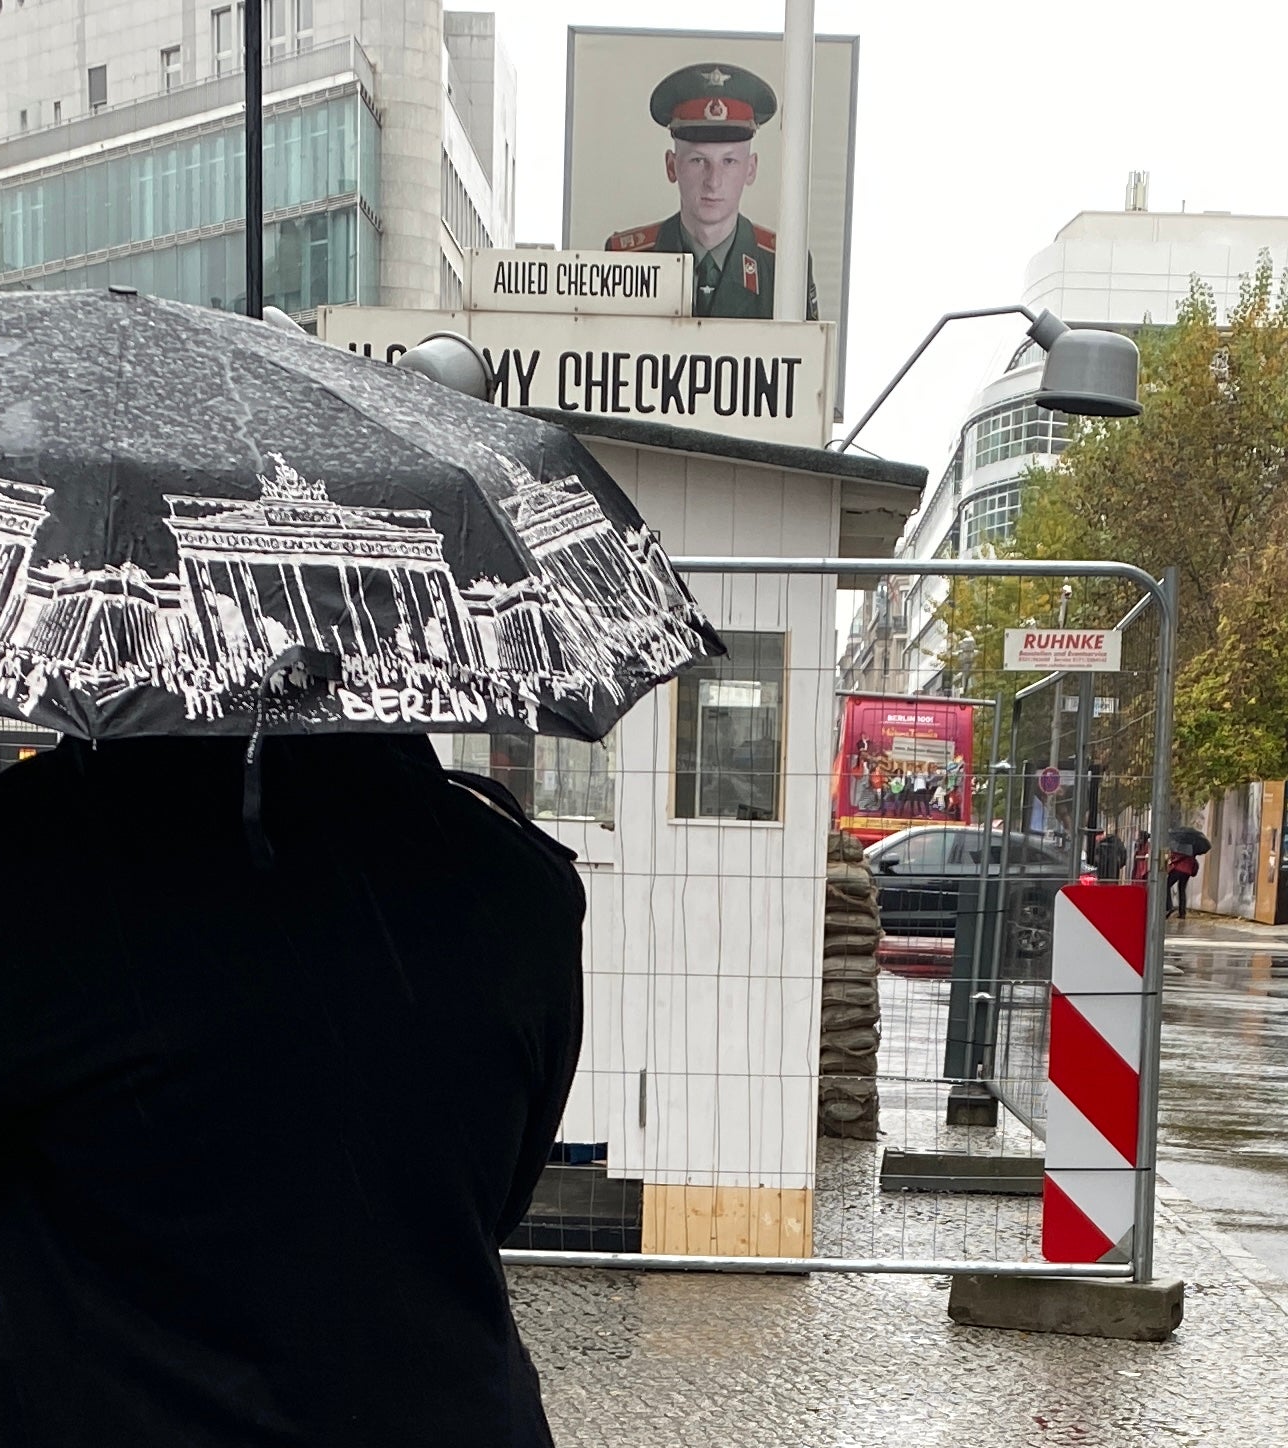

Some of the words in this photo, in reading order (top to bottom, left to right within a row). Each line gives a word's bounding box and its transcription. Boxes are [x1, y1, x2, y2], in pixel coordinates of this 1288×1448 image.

[493, 260, 549, 296] ALLIED
[556, 262, 662, 299] CHECKPOINT
[558, 350, 802, 419] CHECKPOINT
[1023, 633, 1105, 650] RUHNKE
[337, 687, 488, 724] BERLIN
